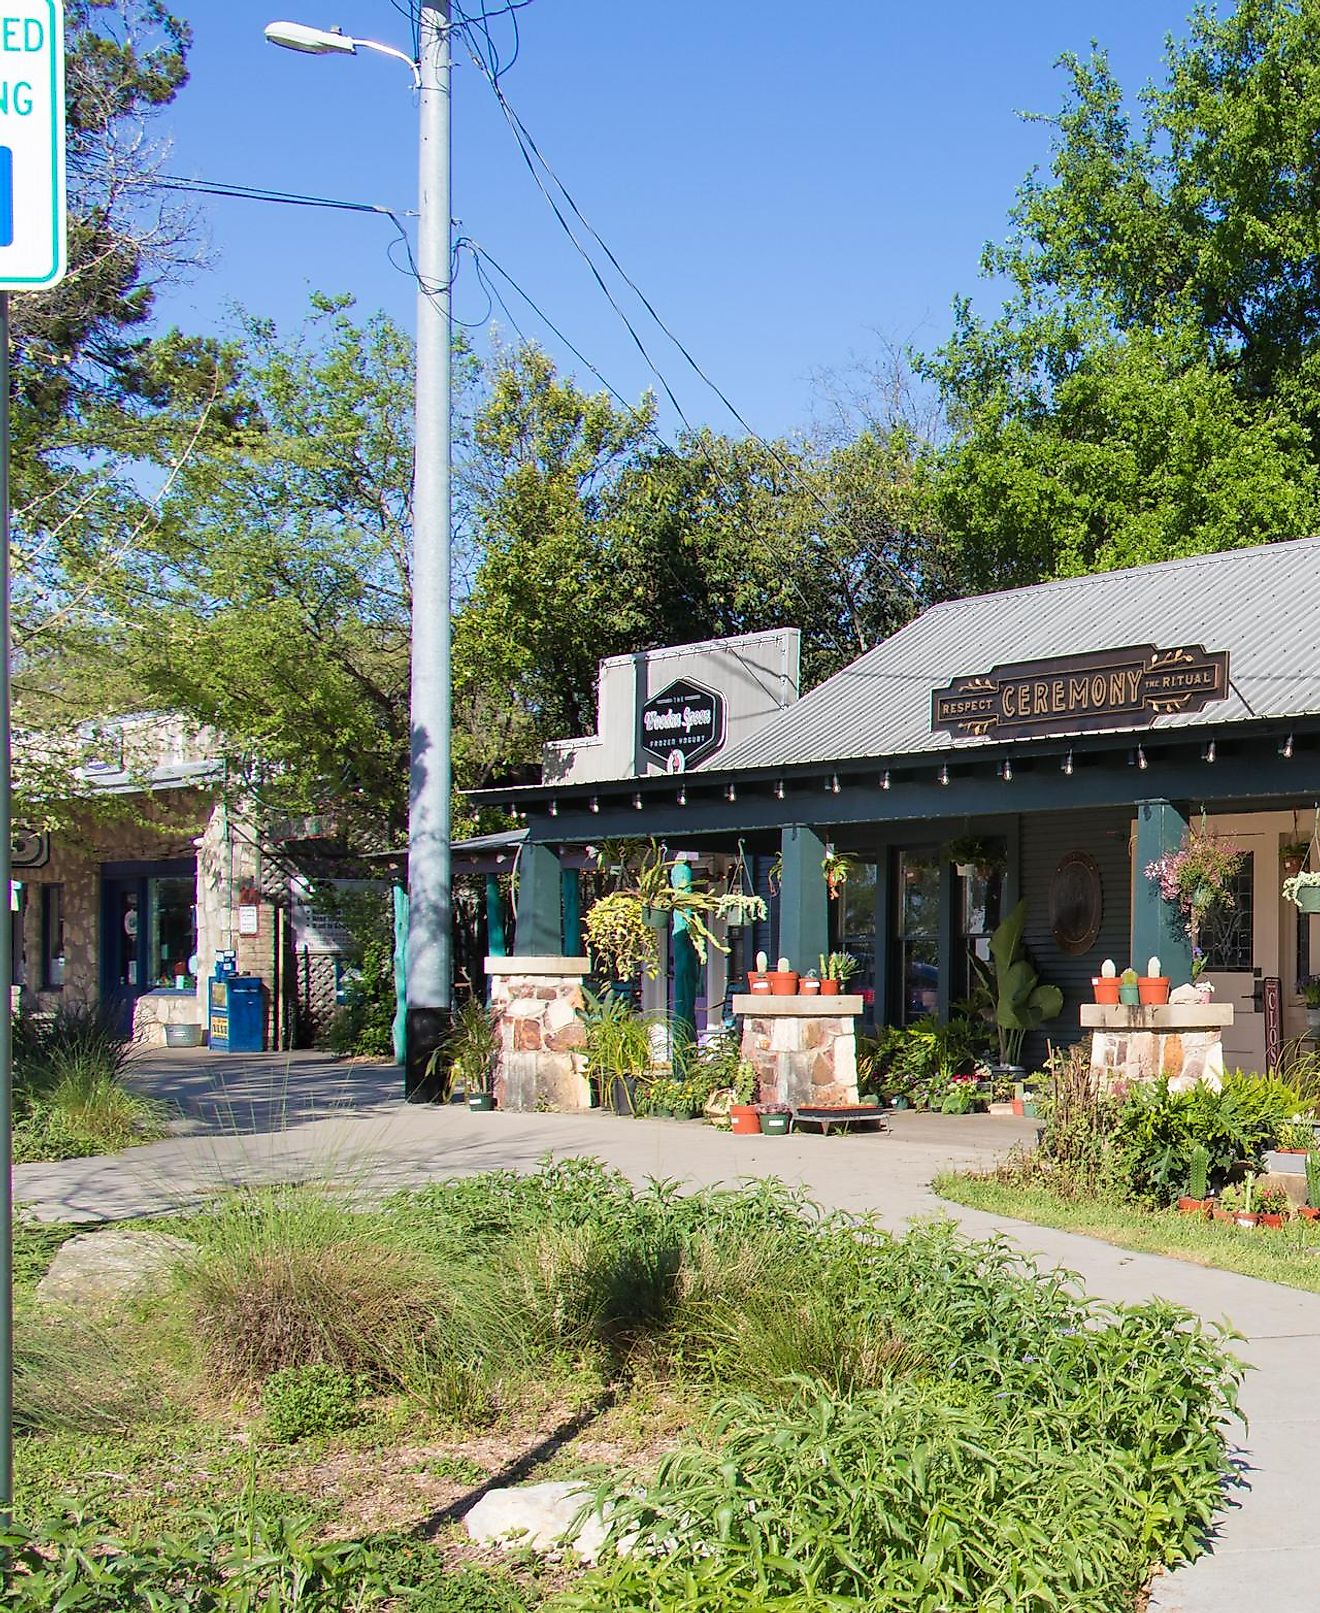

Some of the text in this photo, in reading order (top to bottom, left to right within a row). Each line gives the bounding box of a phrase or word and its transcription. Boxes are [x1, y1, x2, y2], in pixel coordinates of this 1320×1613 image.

[4, 18, 43, 51] ED
[943, 670, 1143, 718] RESPECT CEREMONY
[1162, 672, 1211, 688] RITUAL
[644, 708, 682, 731] Wooden
[649, 739, 675, 747] FROZEN
[1269, 992, 1277, 1065] CLOS
